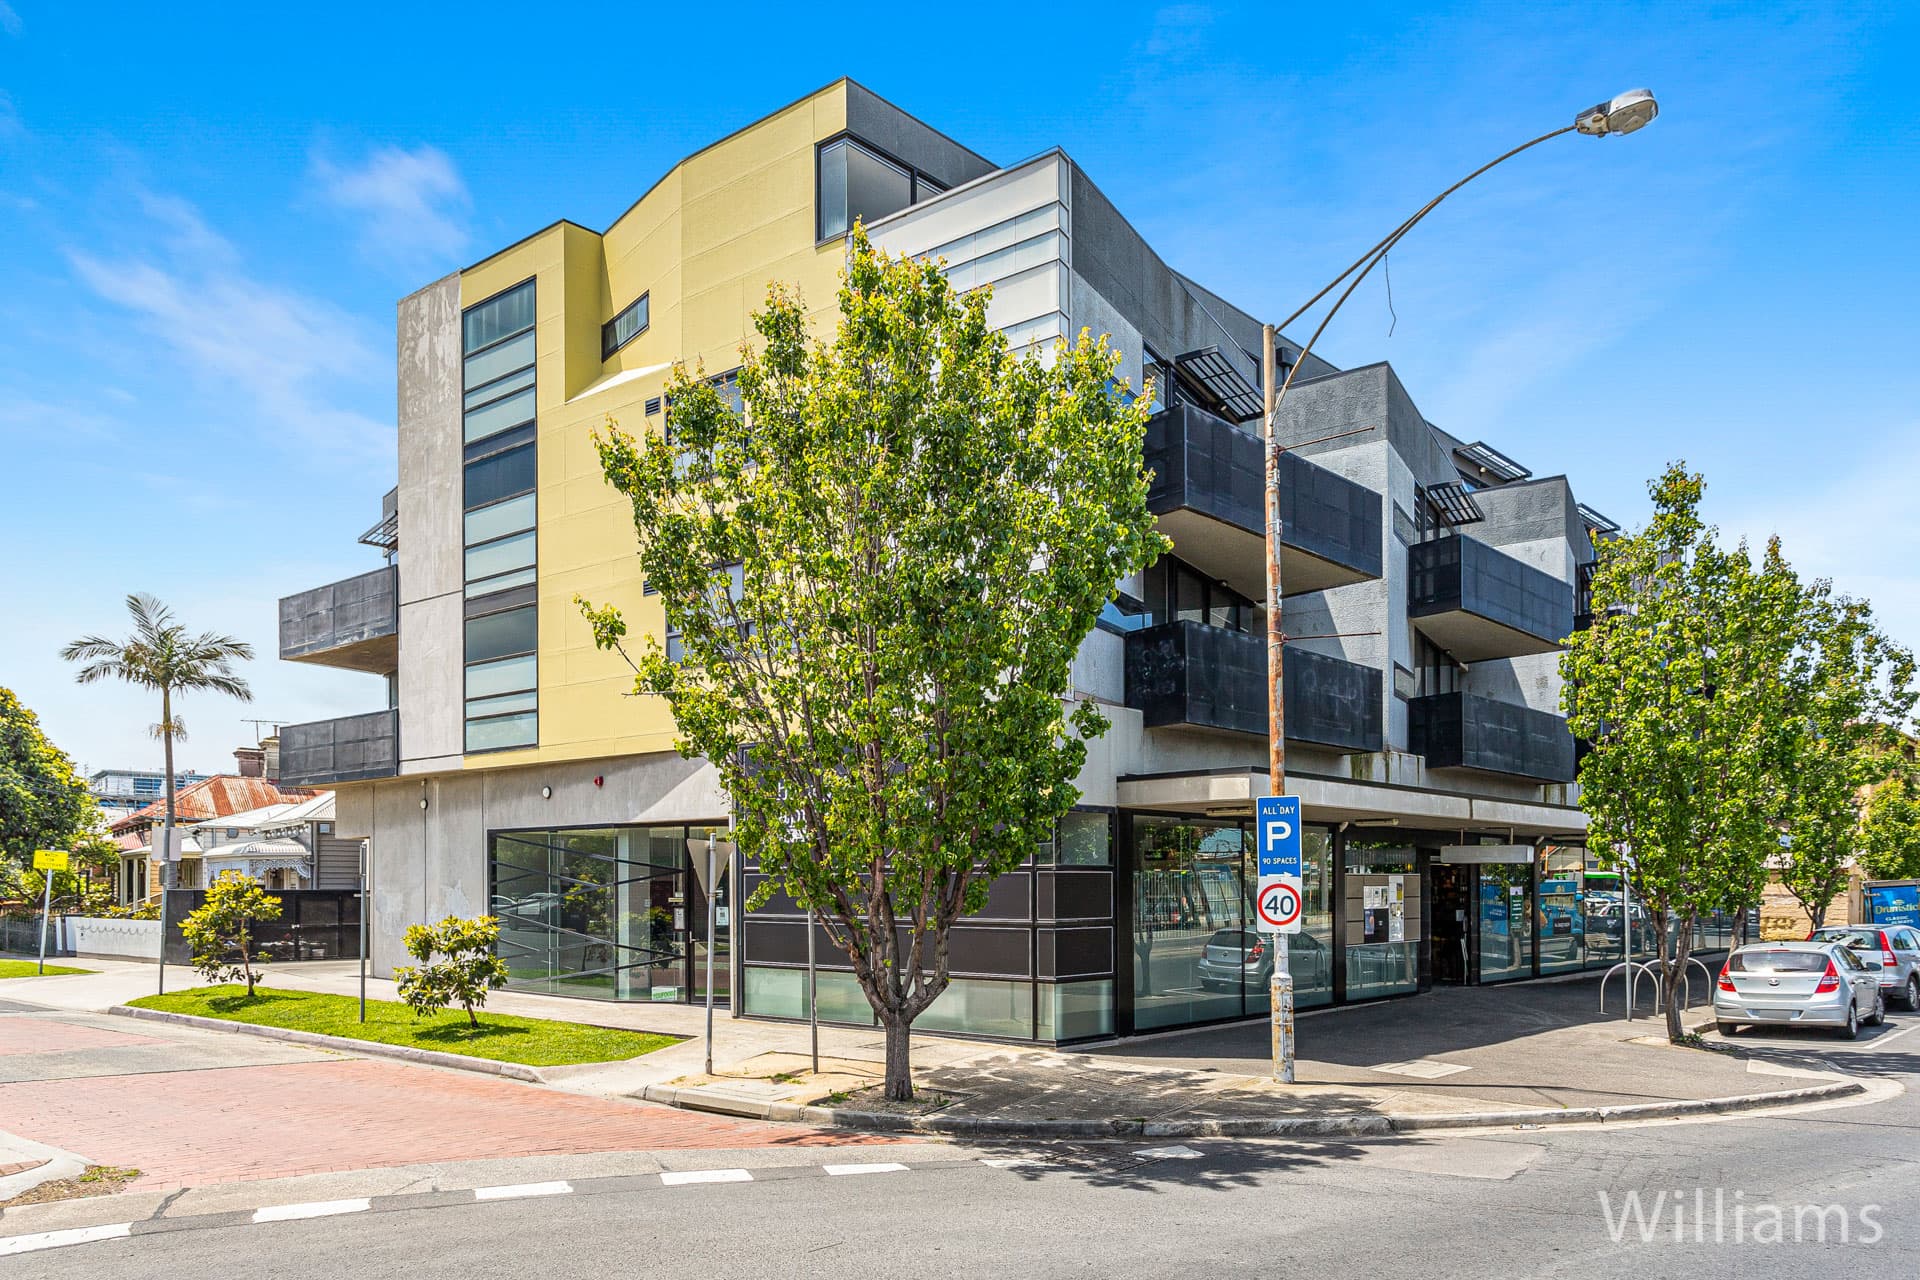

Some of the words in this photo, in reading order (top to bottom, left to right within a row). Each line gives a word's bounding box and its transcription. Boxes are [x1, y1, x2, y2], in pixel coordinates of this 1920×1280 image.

[1263, 806, 1277, 815] ALL
[1280, 806, 1295, 815] DAY
[1266, 821, 1291, 851] P
[1262, 857, 1270, 865] 90
[1272, 857, 1297, 865] SPACES
[1264, 895, 1294, 916] 40
